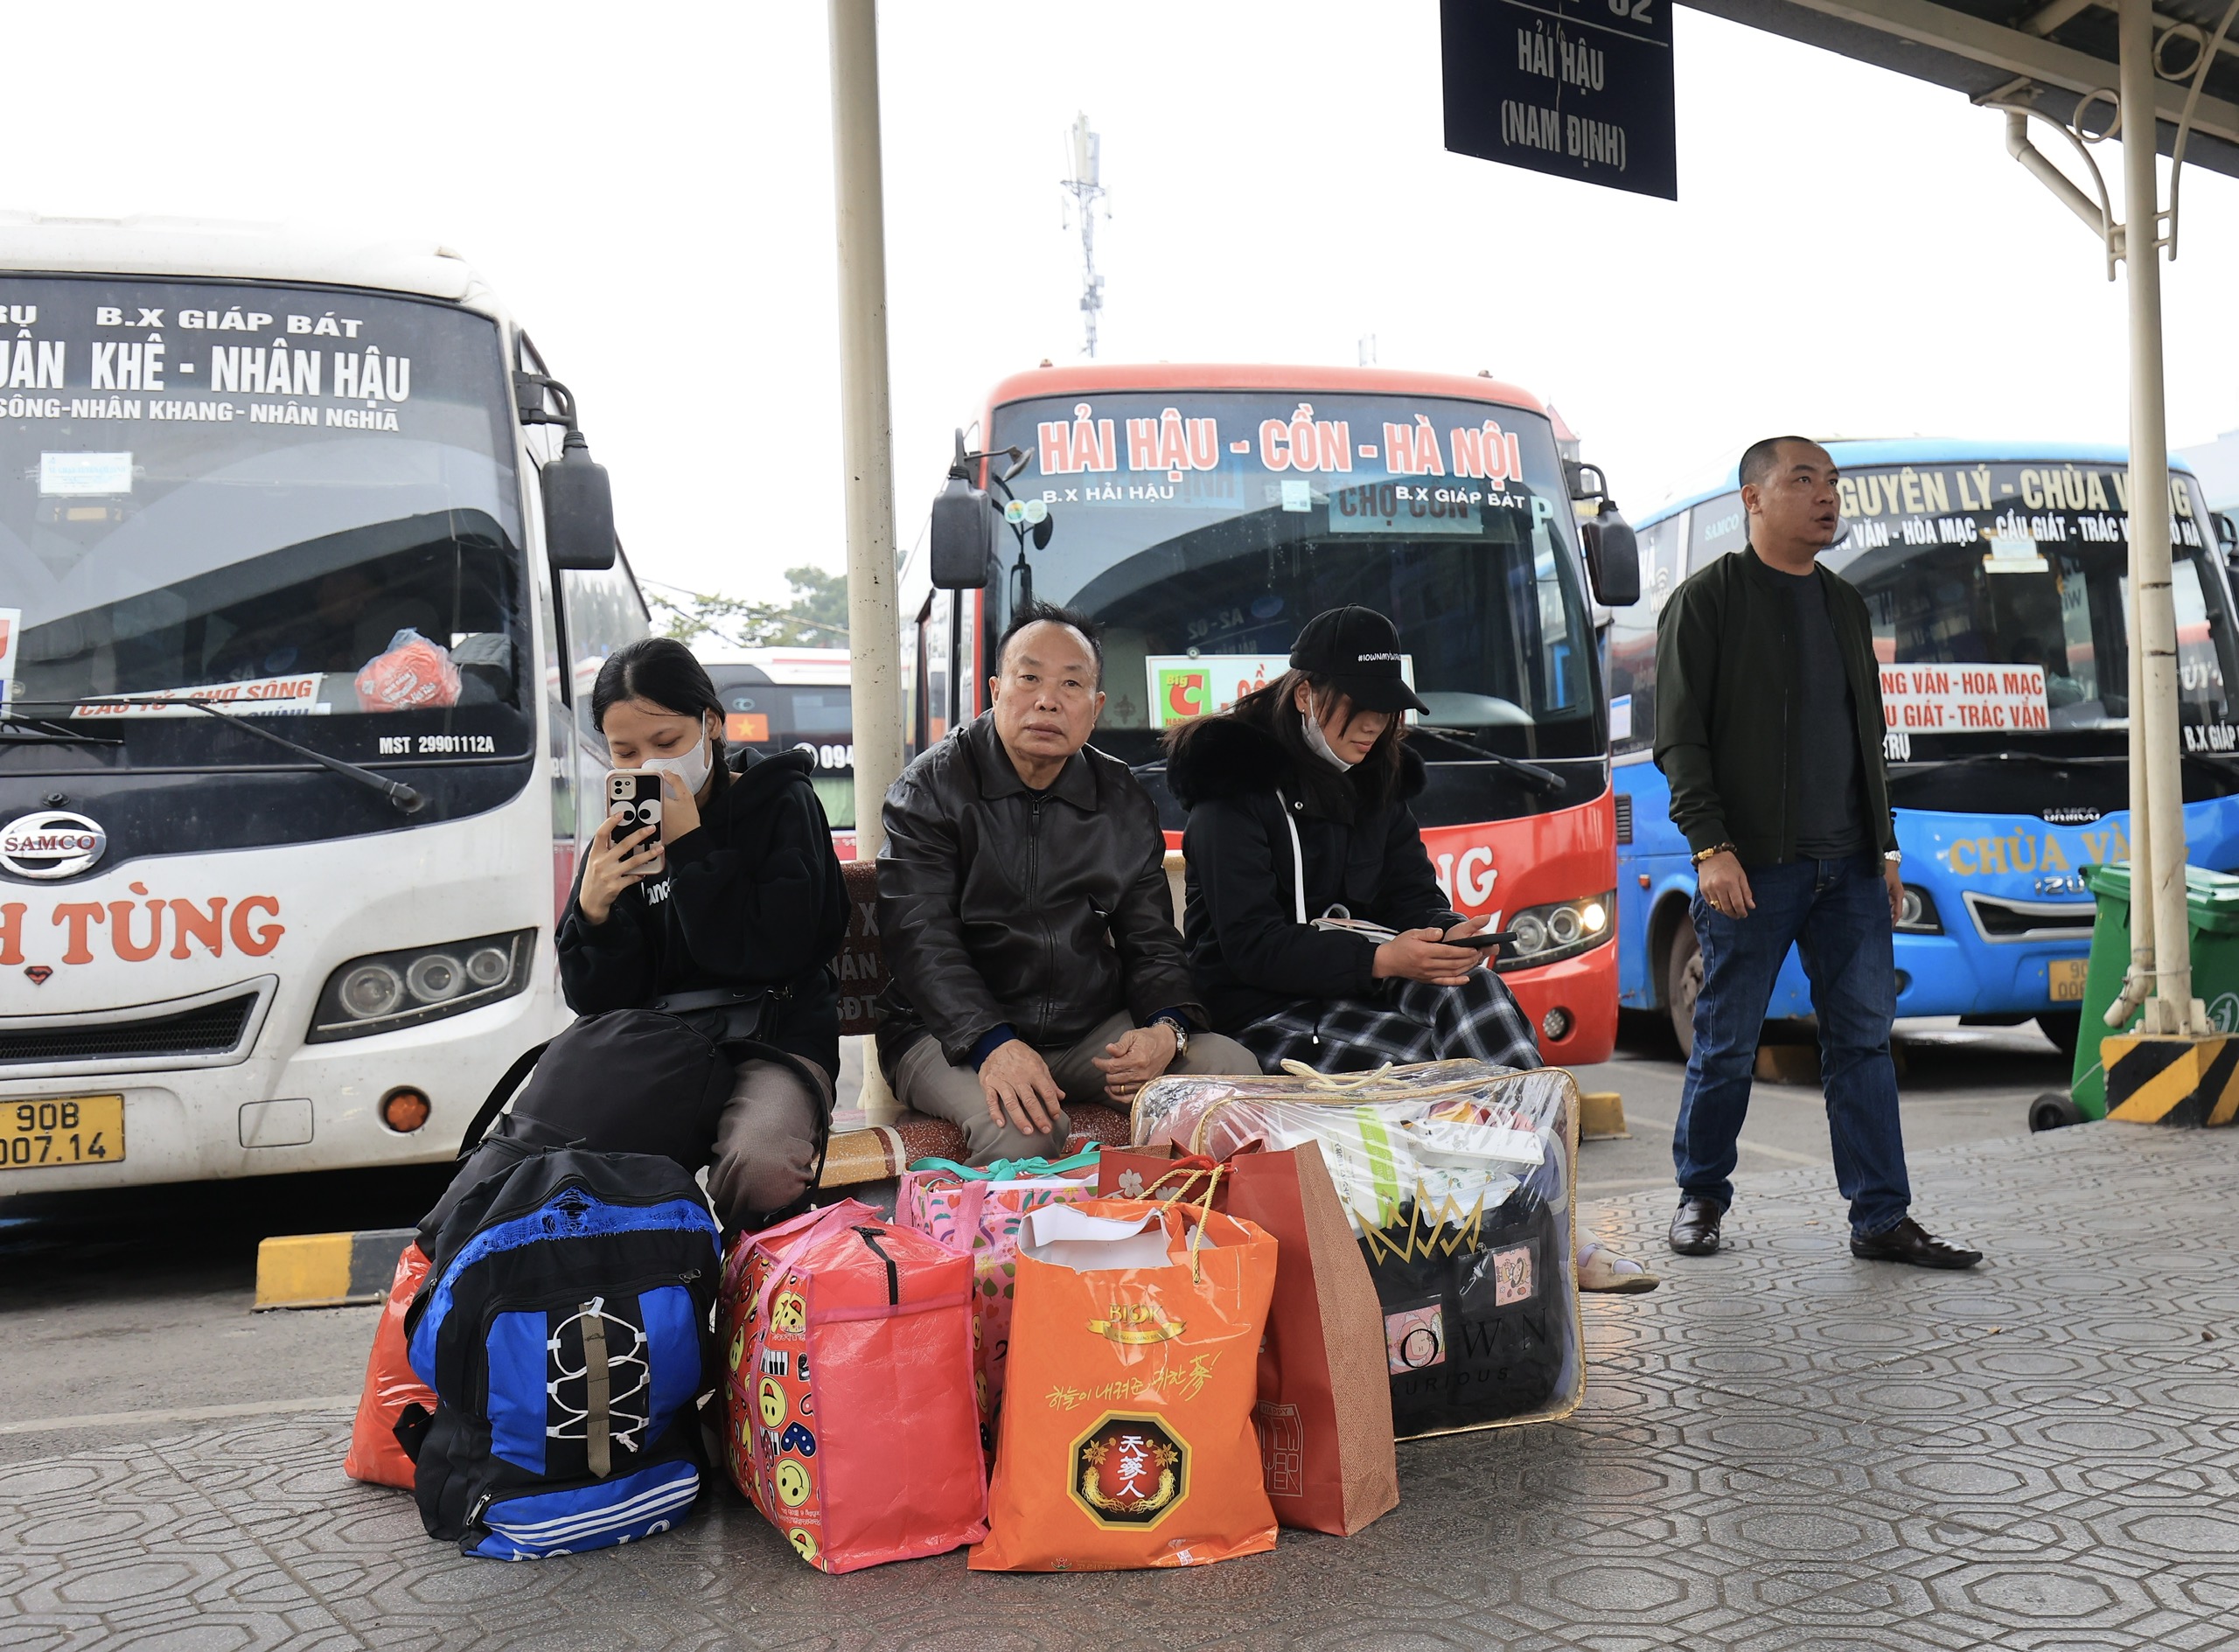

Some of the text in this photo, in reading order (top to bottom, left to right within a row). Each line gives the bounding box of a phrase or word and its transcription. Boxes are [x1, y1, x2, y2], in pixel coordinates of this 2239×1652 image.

[1517, 19, 1605, 95] HẢI HẬU
[1501, 99, 1627, 172] (NAM ĐỊNH)
[96, 306, 165, 328] B.X
[178, 306, 274, 331] GIÁP
[287, 311, 364, 338] BÁT
[91, 332, 165, 391] KHÊ
[211, 338, 321, 397] NHÂN
[333, 345, 410, 408] HẬU
[250, 401, 318, 426] NHÂN
[1037, 403, 1118, 475] HẢI
[1126, 408, 1219, 482] HẬU
[1259, 403, 1353, 472] CỒN
[1383, 414, 1446, 477] HÀ
[1450, 419, 1524, 491] NỘI
[1043, 491, 1079, 504] B.X
[1085, 482, 1122, 502] HẢI
[1129, 483, 1175, 503] HẬU
[1395, 485, 1524, 509] B.X GIÁP BÁT
[1956, 464, 1993, 511] LÝ
[2019, 464, 2110, 511] CHÙA
[1852, 518, 1890, 549] VĂN
[1901, 514, 1938, 546] HÒA
[1937, 515, 1978, 547] MẠC
[1995, 508, 2028, 540] CẦU
[2031, 512, 2067, 542] GIÁT
[2078, 512, 2118, 542] TRÁC
[247, 679, 313, 699] SÔNG
[1166, 673, 1189, 688] Big
[1912, 666, 1950, 694] VĂN
[1962, 673, 1998, 694] HOA
[1904, 700, 1943, 727] GIÁT
[1957, 700, 2005, 728] TRÁC
[379, 735, 496, 755] MST 29901112A
[4, 835, 97, 853] SAMCO
[1950, 826, 2070, 876] CHÙA
[52, 882, 286, 965] TÙNG
[17, 1102, 80, 1132] 90B
[1263, 1405, 1288, 1416] HAPPY
